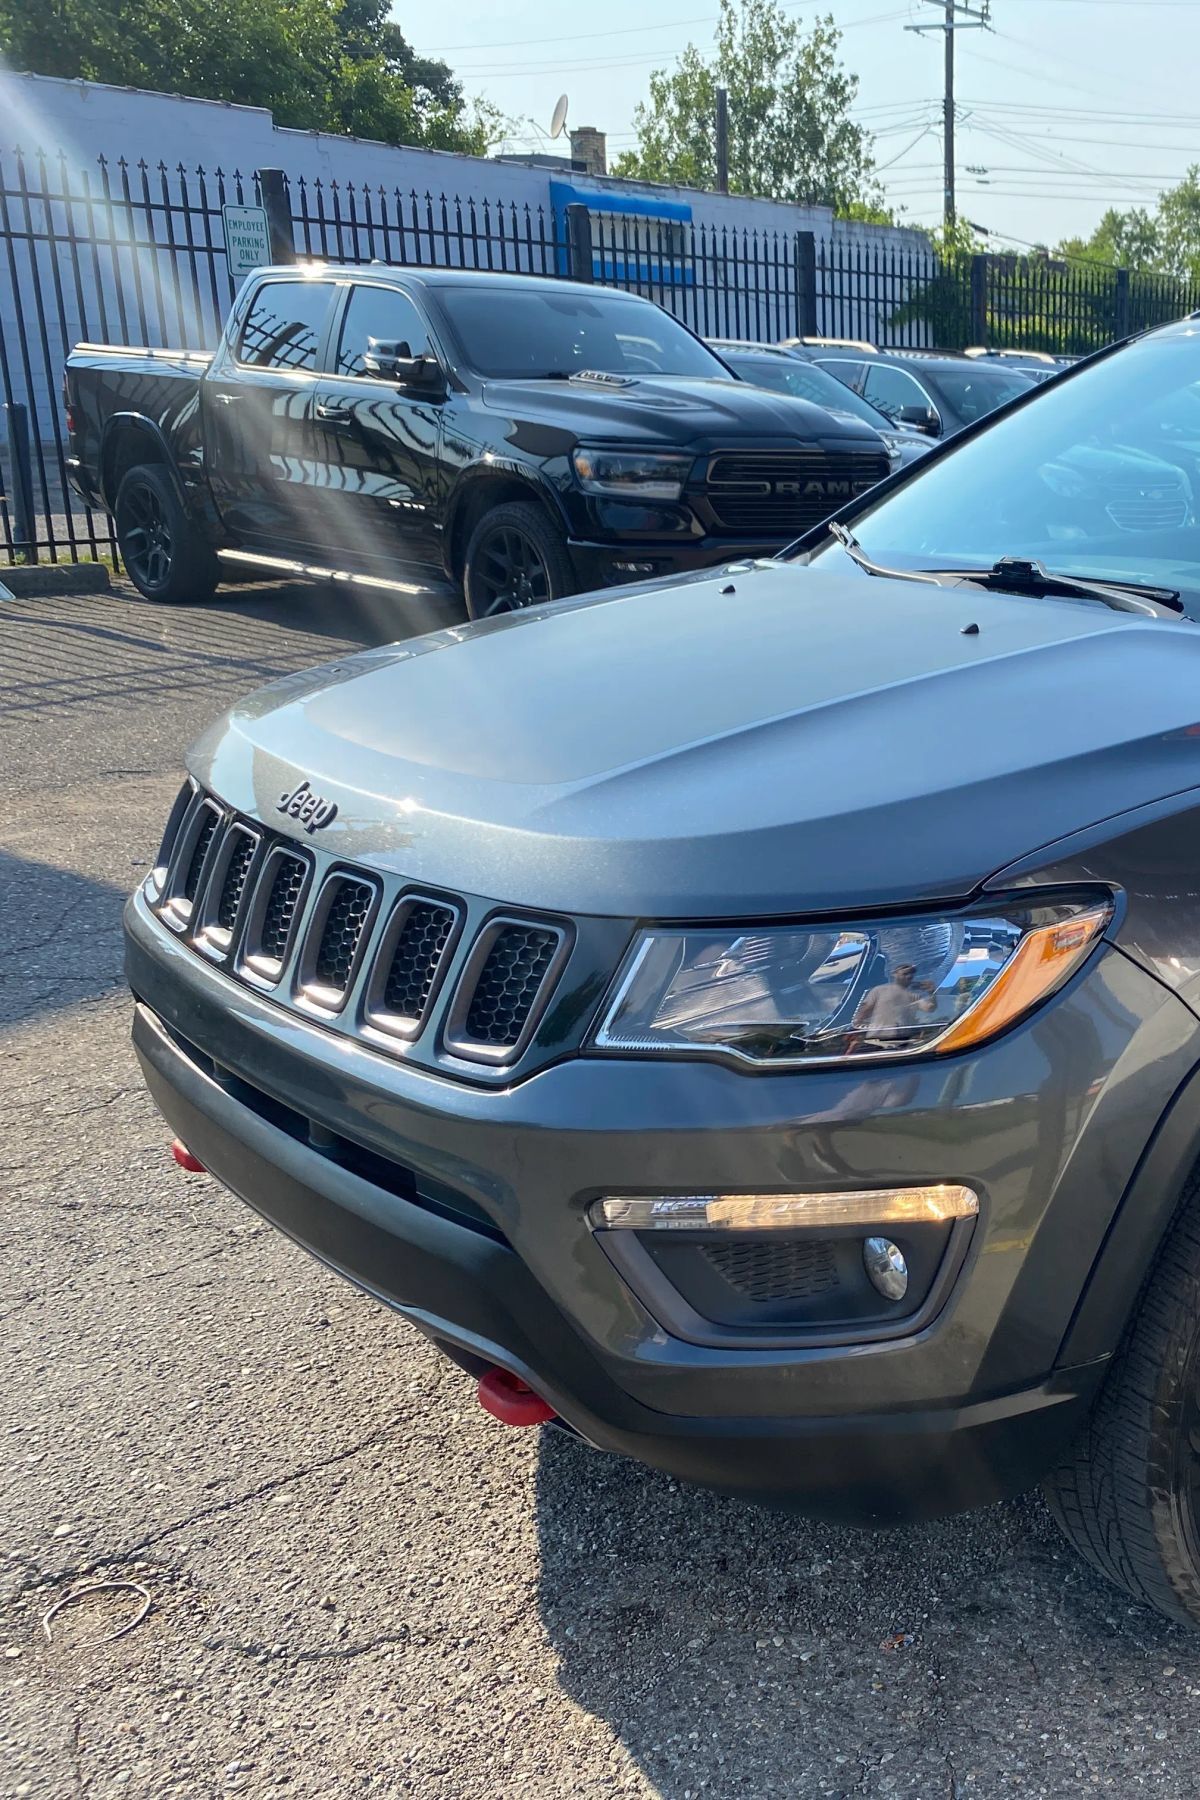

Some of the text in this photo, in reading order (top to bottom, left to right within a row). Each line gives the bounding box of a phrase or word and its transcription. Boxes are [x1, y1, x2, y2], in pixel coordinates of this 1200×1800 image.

[228, 219, 265, 232] EMPLOYEE
[232, 236, 265, 249] PARKING
[239, 250, 260, 261] ONLY
[775, 481, 849, 495] RAM
[275, 780, 339, 835] Jeep
